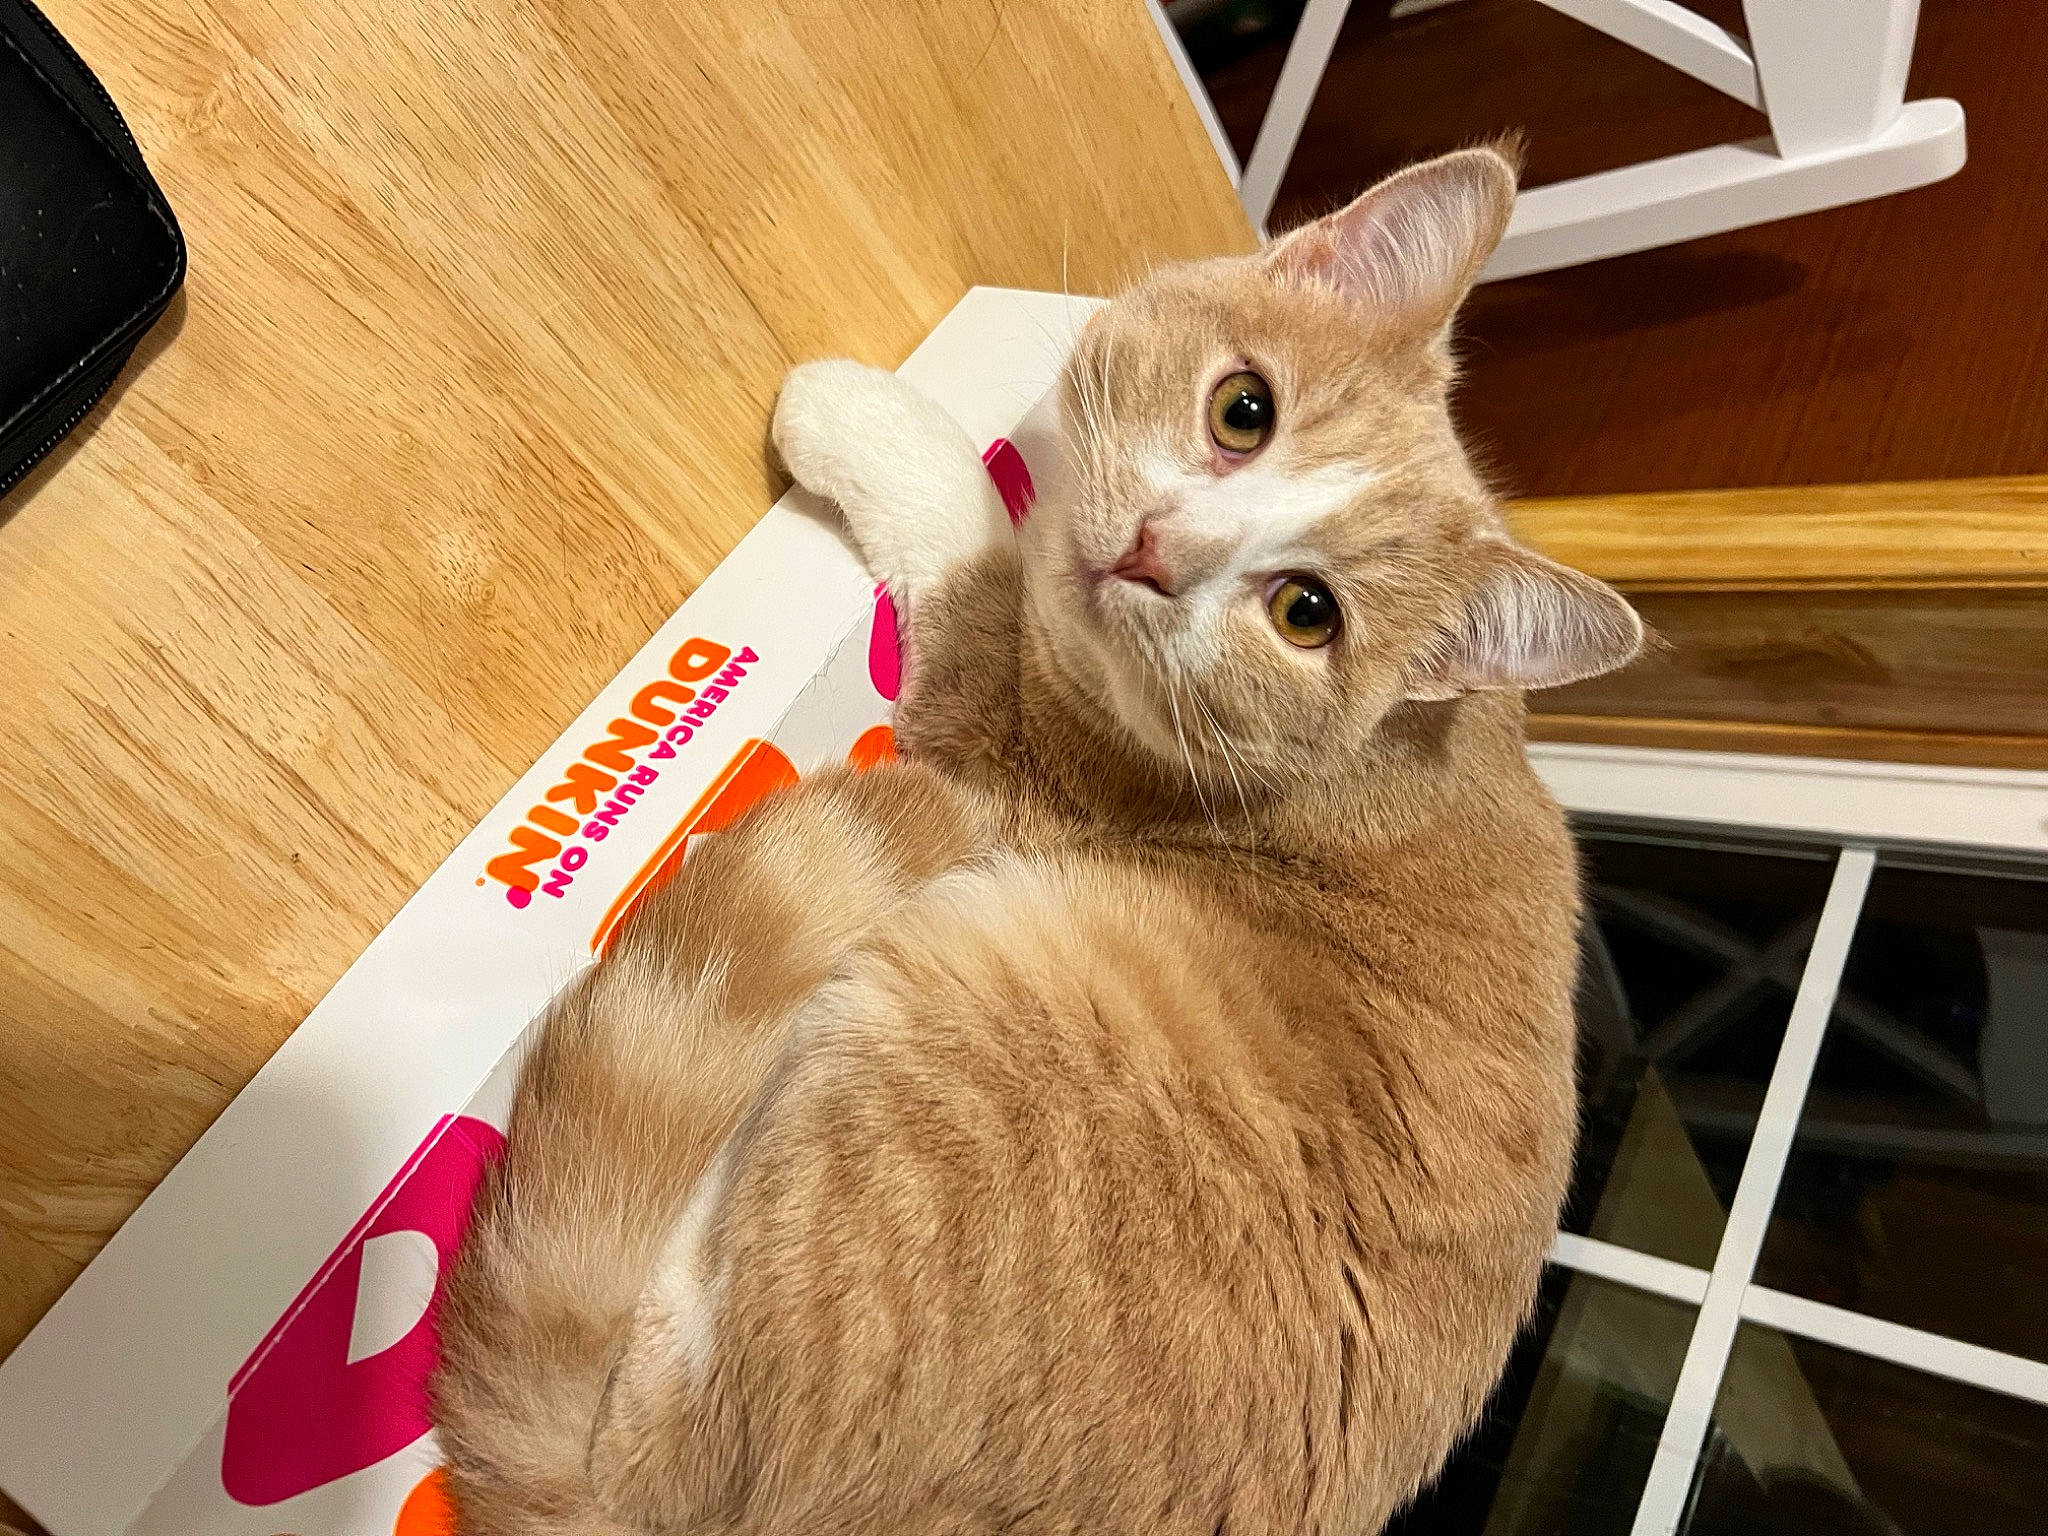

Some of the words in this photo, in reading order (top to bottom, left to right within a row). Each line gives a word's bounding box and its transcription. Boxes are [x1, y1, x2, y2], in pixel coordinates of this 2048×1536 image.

[648, 646, 760, 760] AMERICA
[581, 764, 660, 843] RUNS
[541, 846, 589, 899] ON
